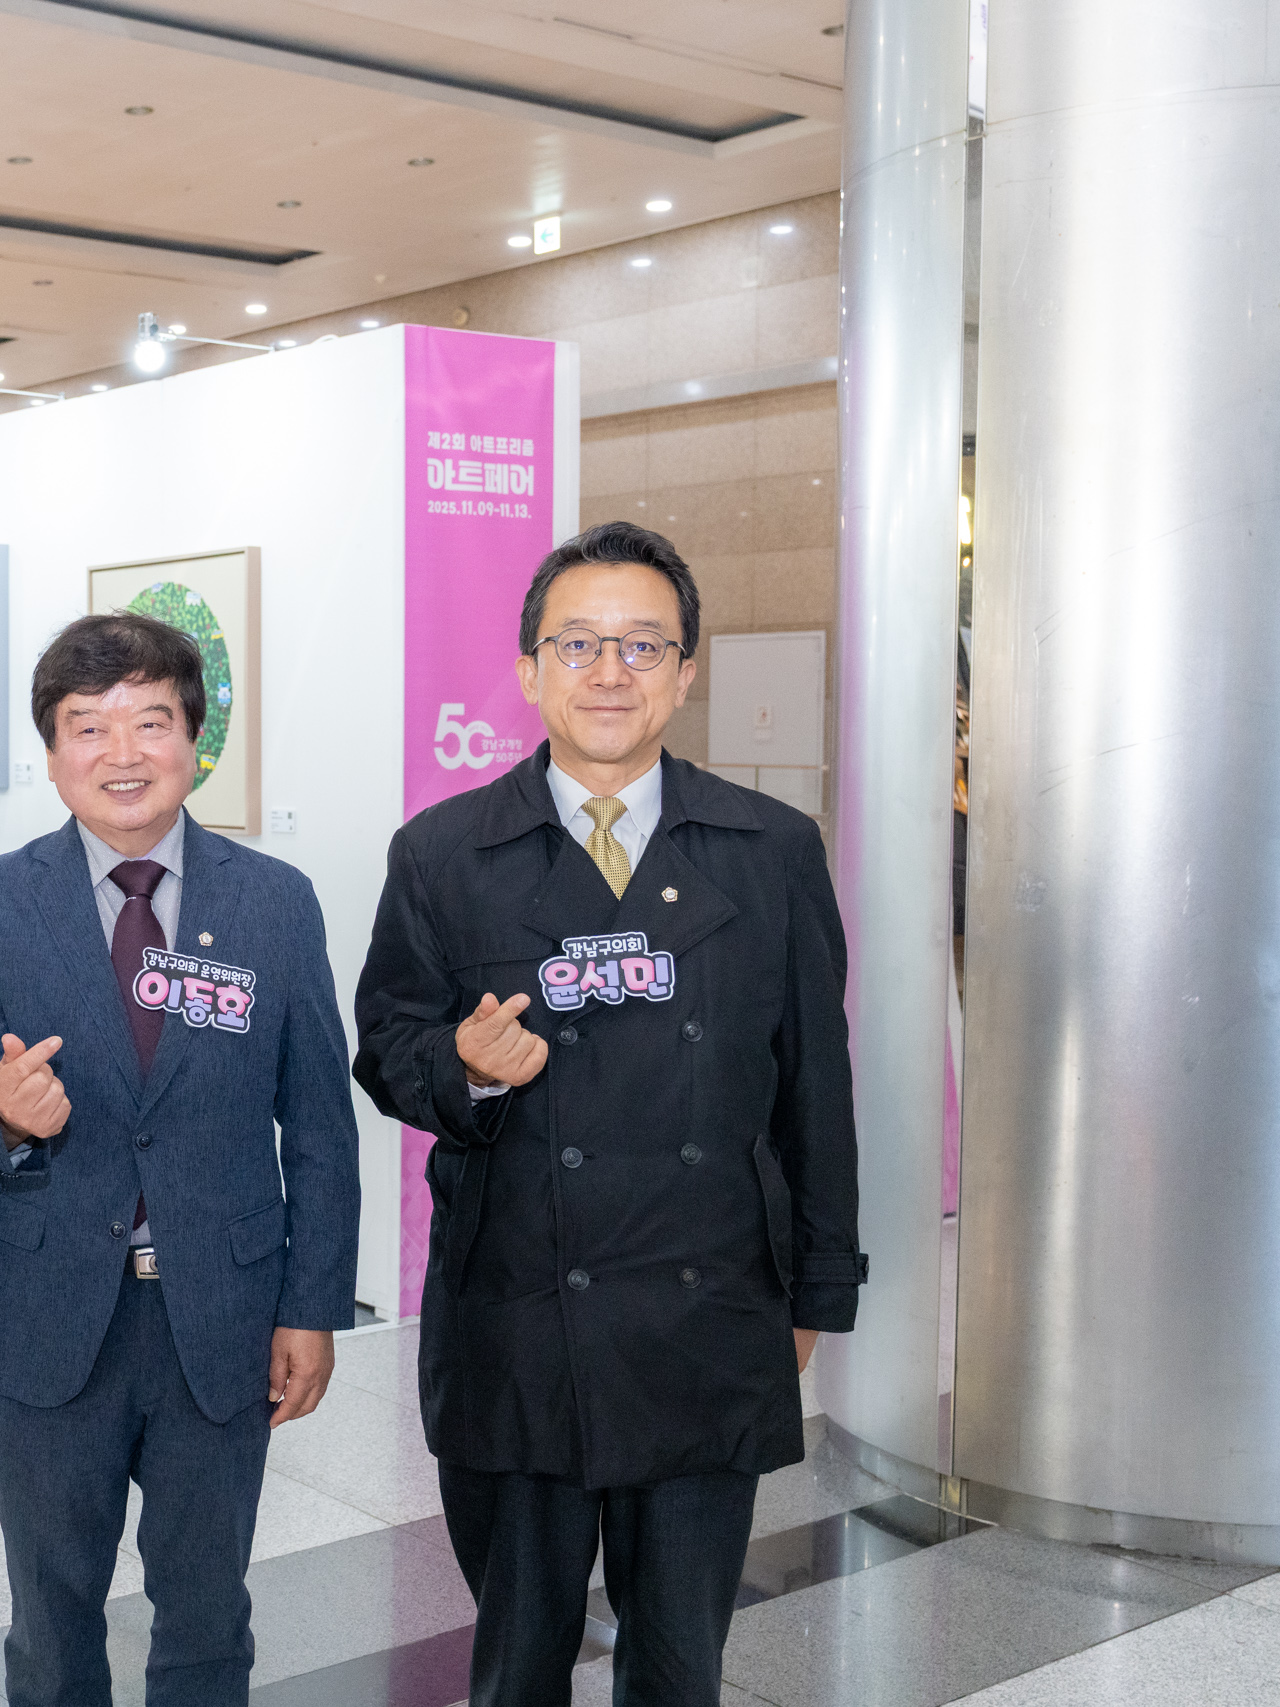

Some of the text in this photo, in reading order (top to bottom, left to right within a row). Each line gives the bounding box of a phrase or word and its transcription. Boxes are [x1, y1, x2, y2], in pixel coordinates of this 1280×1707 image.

[427, 431, 534, 457] 제2회 아트프리즘
[427, 457, 534, 497] 아트페어
[427, 500, 532, 519] 2025.11.09-11.13.
[567, 936, 643, 960] 강남구의회
[147, 952, 252, 988] 강남구의회 운영위원장
[544, 956, 670, 1006] 윤석민
[138, 971, 251, 1028] 이동호
